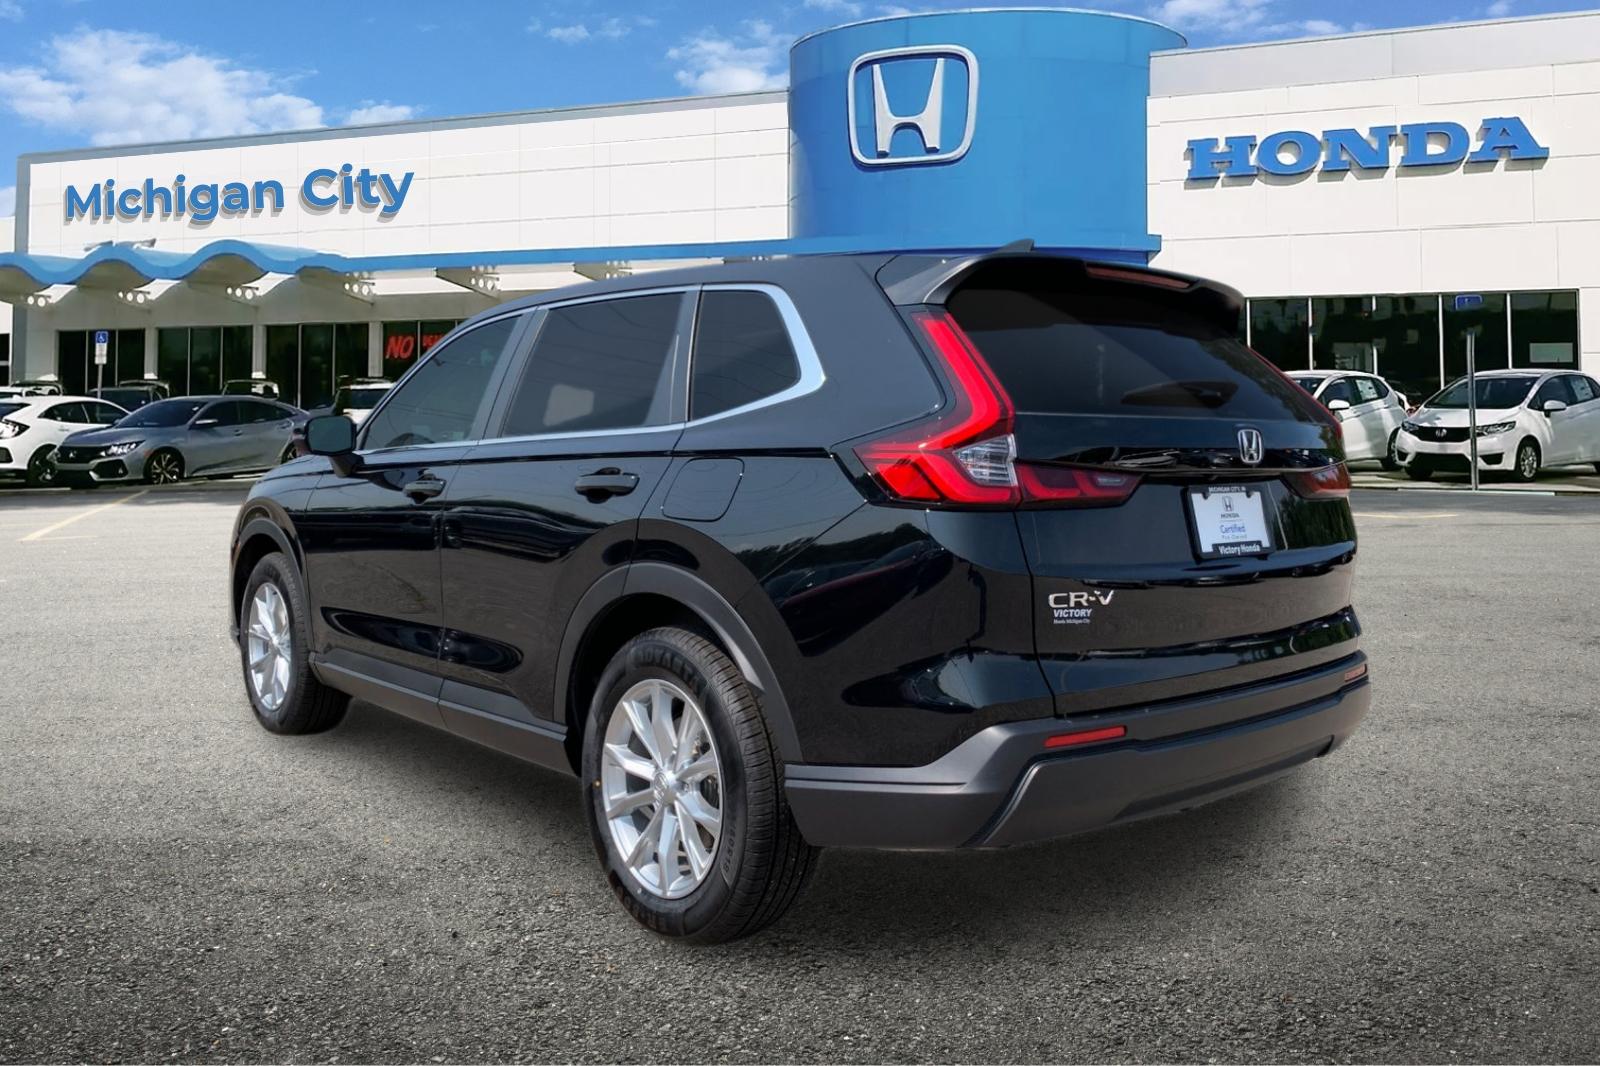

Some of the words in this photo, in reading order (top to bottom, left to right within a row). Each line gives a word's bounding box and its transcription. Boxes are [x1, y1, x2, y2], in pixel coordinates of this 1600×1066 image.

[1186, 116, 1550, 182] HONDA
[66, 173, 285, 223] Michigan
[302, 162, 415, 215] City
[385, 335, 415, 359] NO
[1219, 546, 1240, 555] Victory
[1240, 544, 1260, 552] Honda
[1048, 590, 1114, 608] CR-V
[1053, 608, 1092, 618] VICTORY
